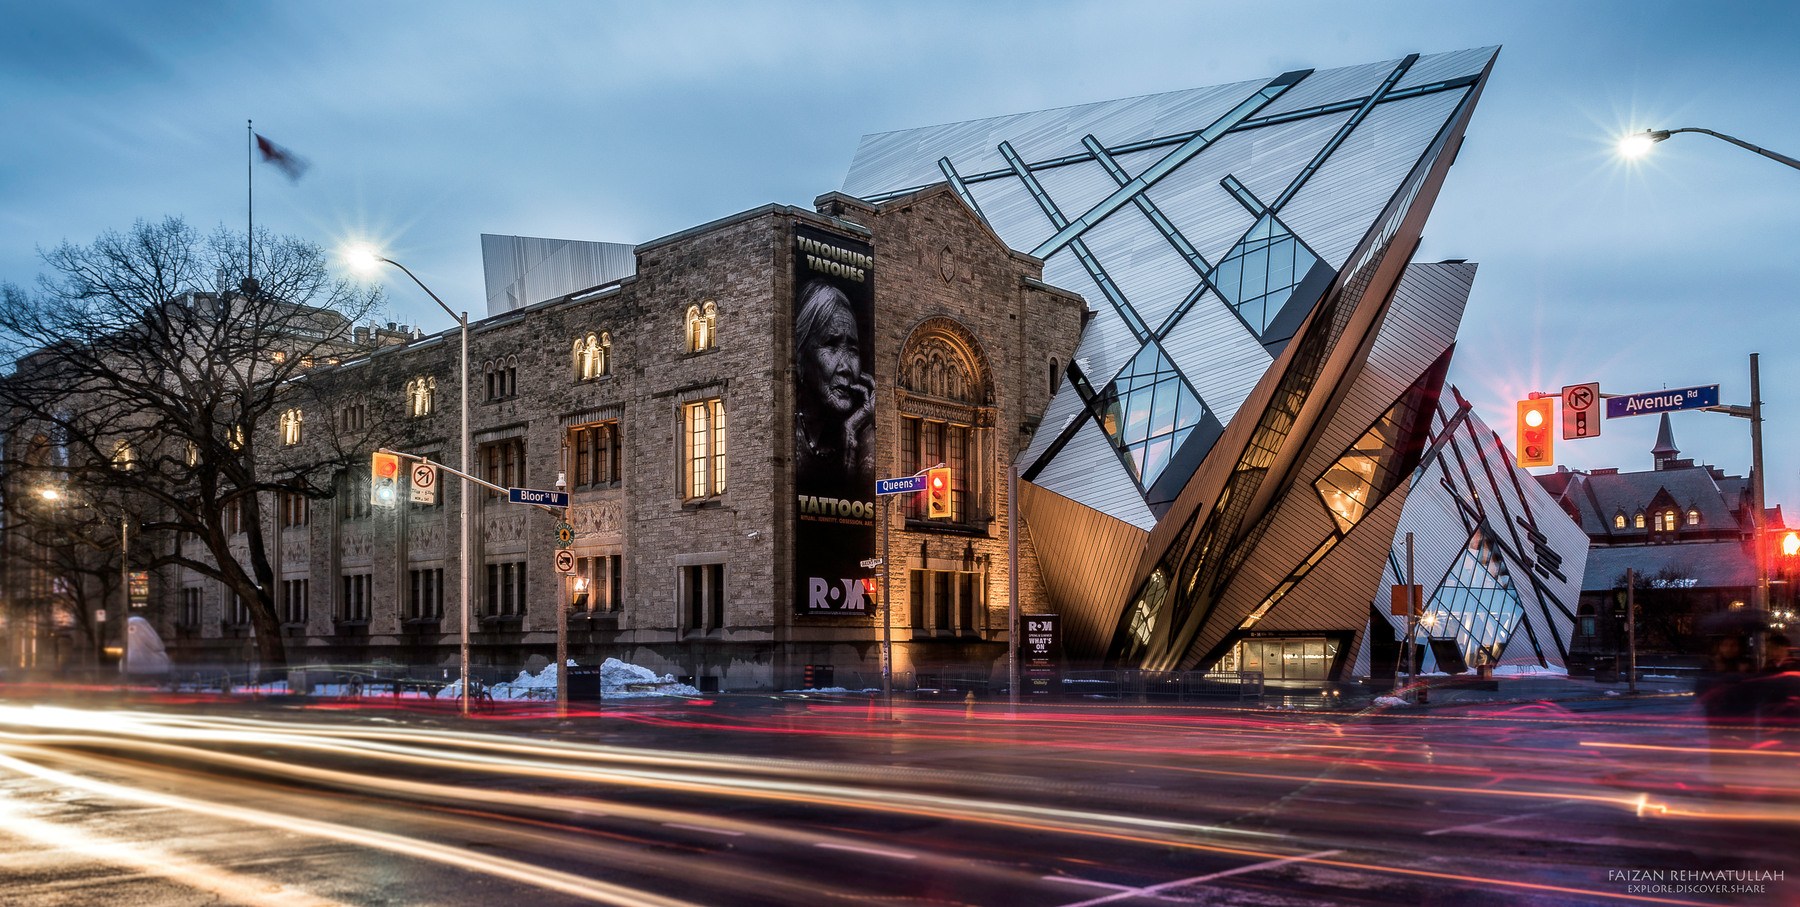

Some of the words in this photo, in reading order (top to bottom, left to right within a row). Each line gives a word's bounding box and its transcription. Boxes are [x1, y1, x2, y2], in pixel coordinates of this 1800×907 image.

[797, 235, 873, 270] TATOUEURS
[1626, 394, 1683, 411] Avenue
[1687, 390, 1698, 398] Rd
[882, 480, 914, 491] Queens
[520, 490, 545, 502] Bloor
[551, 493, 559, 503] W
[798, 494, 875, 519] TATTOOS
